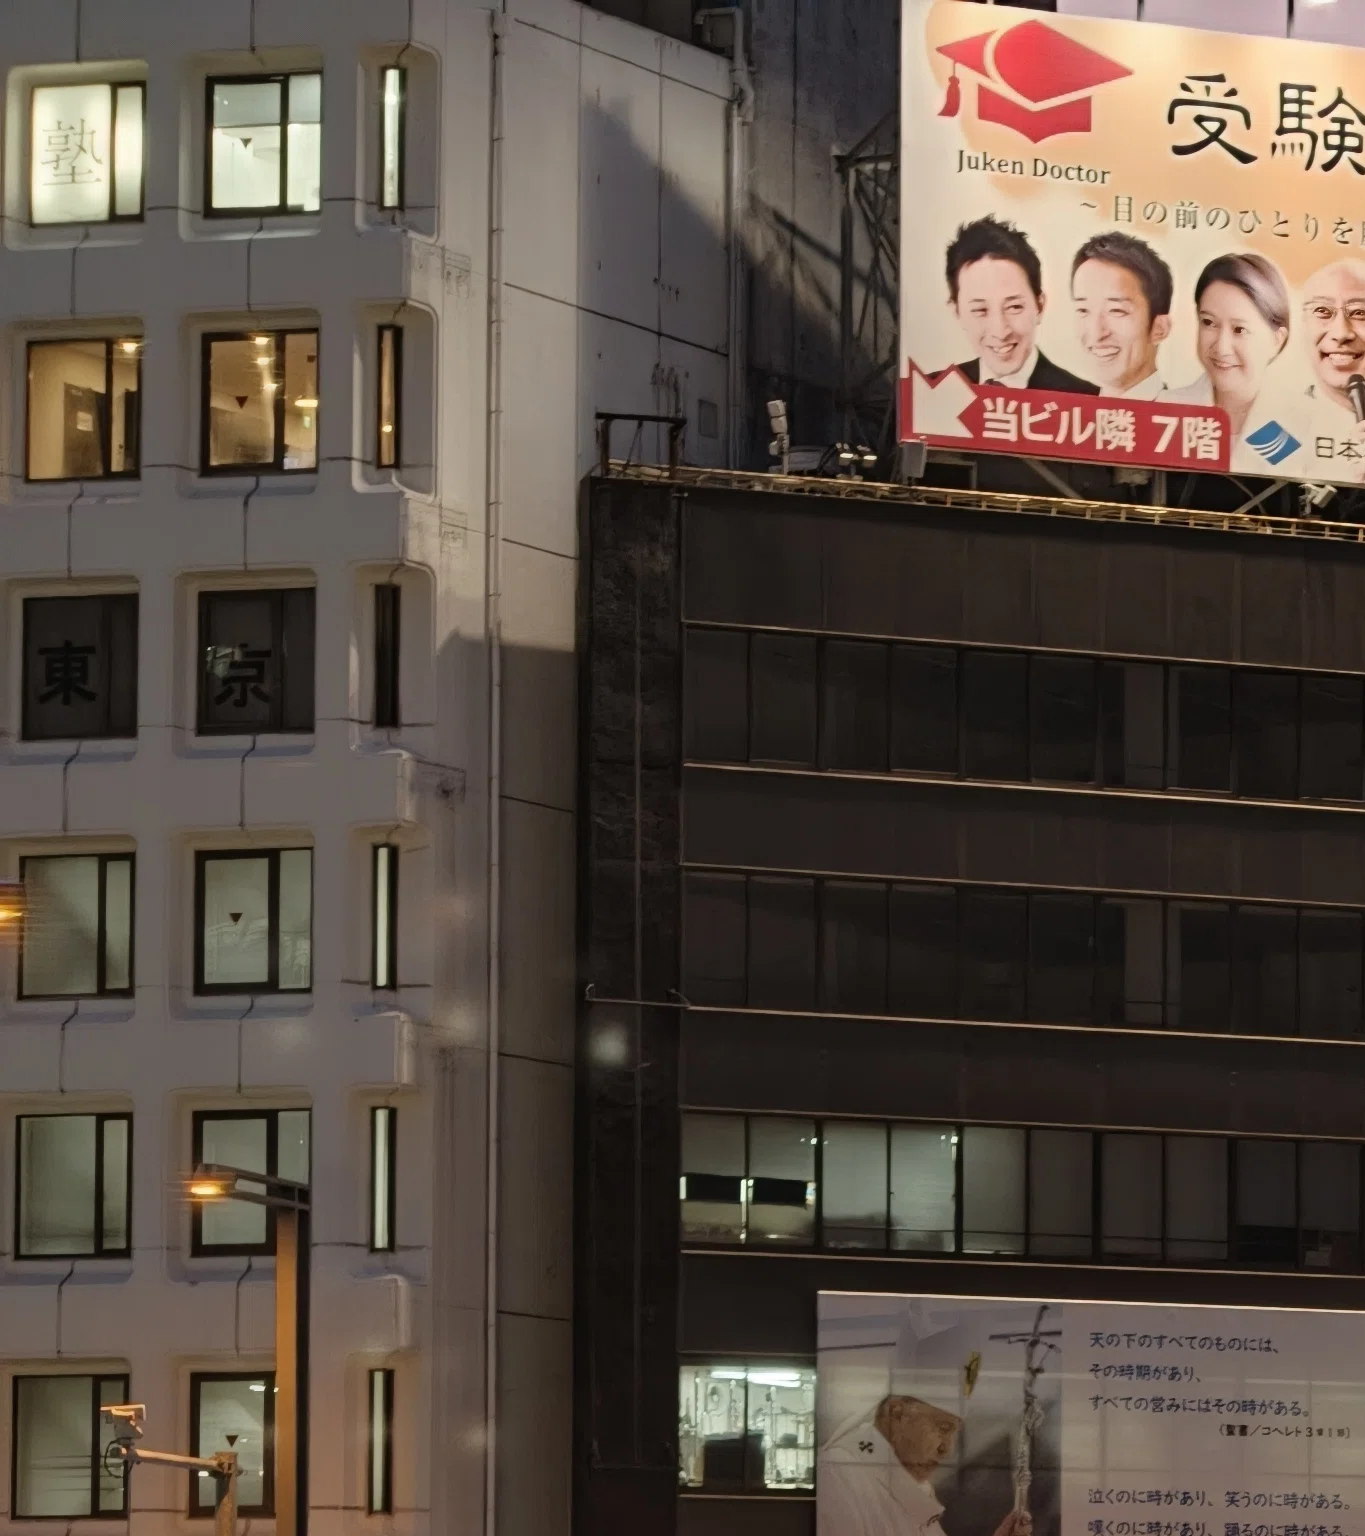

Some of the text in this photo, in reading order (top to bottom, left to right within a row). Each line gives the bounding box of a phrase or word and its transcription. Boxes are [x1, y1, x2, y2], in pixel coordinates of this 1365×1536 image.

[40, 117, 103, 188] 塾
[956, 148, 1110, 185] Juken Doctor
[982, 397, 1222, 461] 当ビル隣 7階
[37, 640, 97, 707] 東
